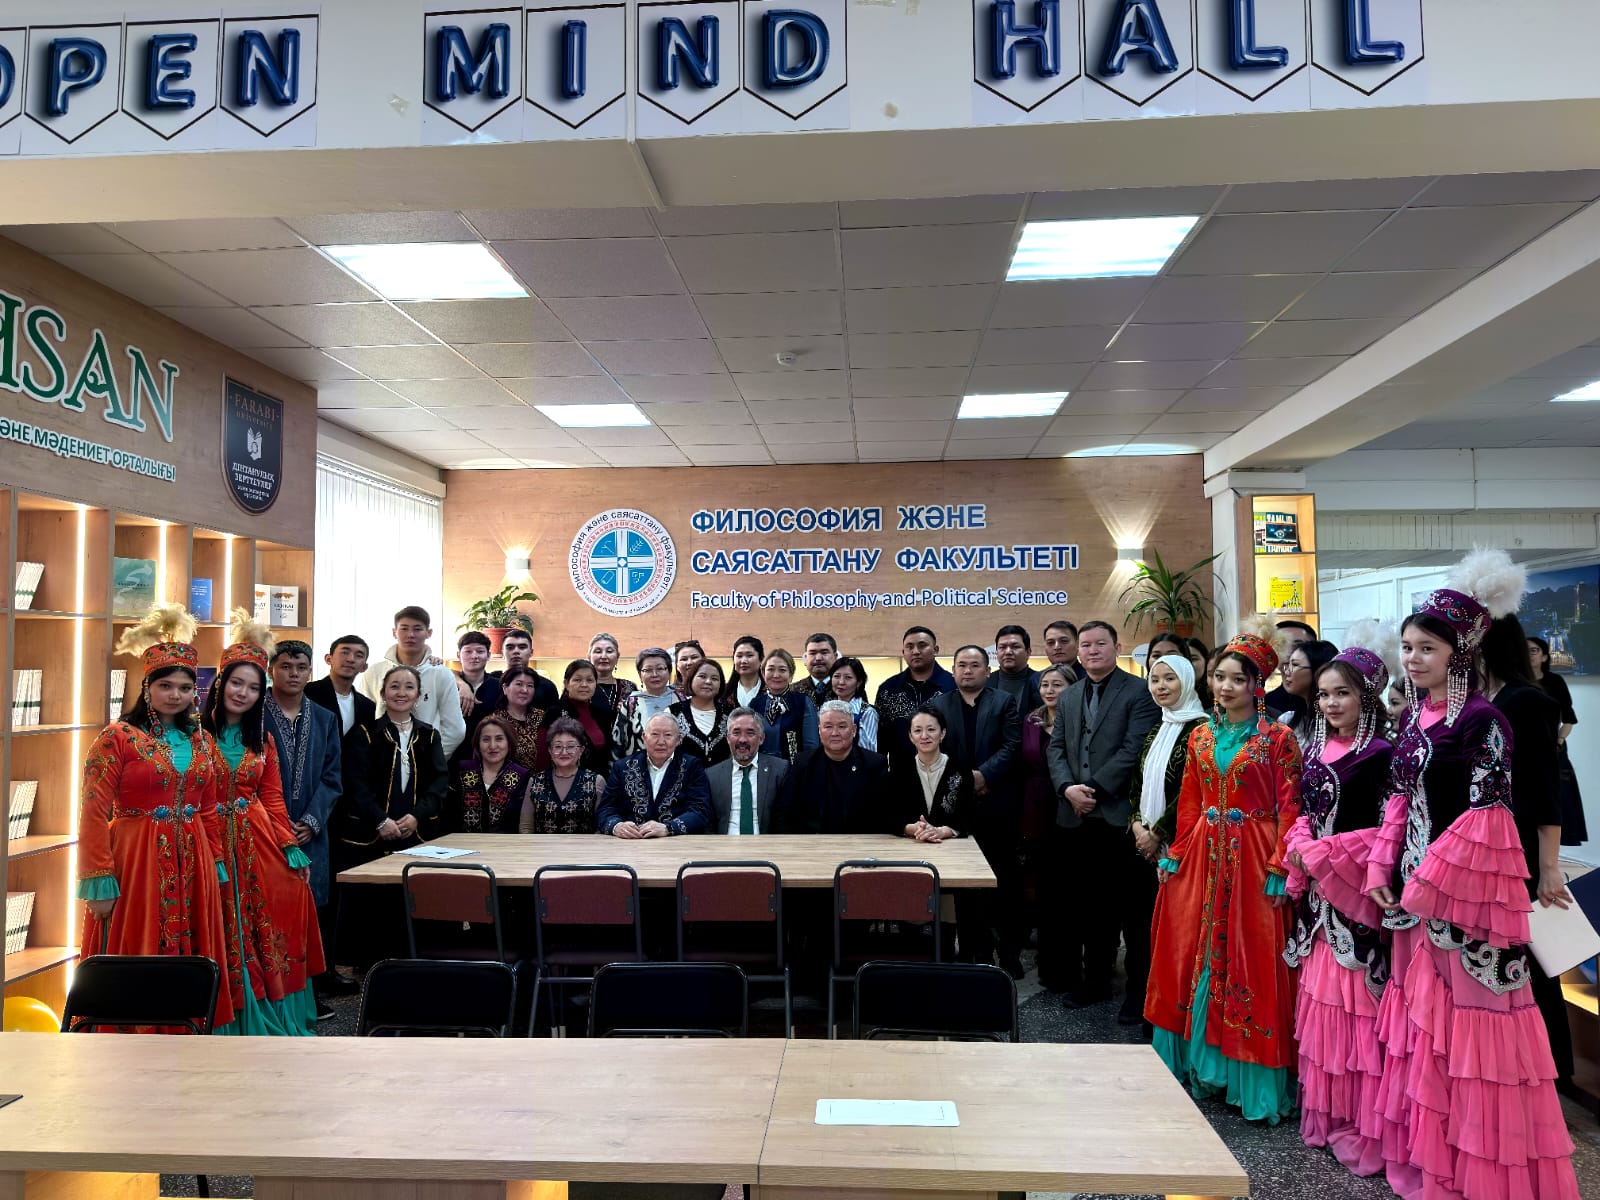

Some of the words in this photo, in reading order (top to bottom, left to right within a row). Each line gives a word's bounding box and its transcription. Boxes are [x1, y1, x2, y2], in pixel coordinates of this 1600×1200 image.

[436, 8, 829, 104] MIND
[993, 0, 1404, 79] HALL
[234, 393, 275, 422] FARABI
[0, 419, 30, 442] ӘНЕ
[34, 429, 111, 464] МӘДЕНИЕТ
[113, 450, 176, 481] ОРТАЛЫҒЫ
[692, 508, 881, 532] ФИЛОСОФИЯ
[898, 505, 986, 529] ЖӘНЕ
[571, 531, 588, 592] философия
[585, 514, 609, 532] және
[610, 511, 664, 536] саясаттану
[692, 550, 881, 573] САЯСАТТАНУ
[896, 546, 1078, 571] ФАКУЛЬТЕТІ
[691, 590, 753, 611] Faculty
[758, 590, 777, 607] of
[781, 589, 878, 610] Philosophy
[883, 589, 916, 606] and
[922, 588, 992, 606] Political
[997, 587, 1067, 605] Science
